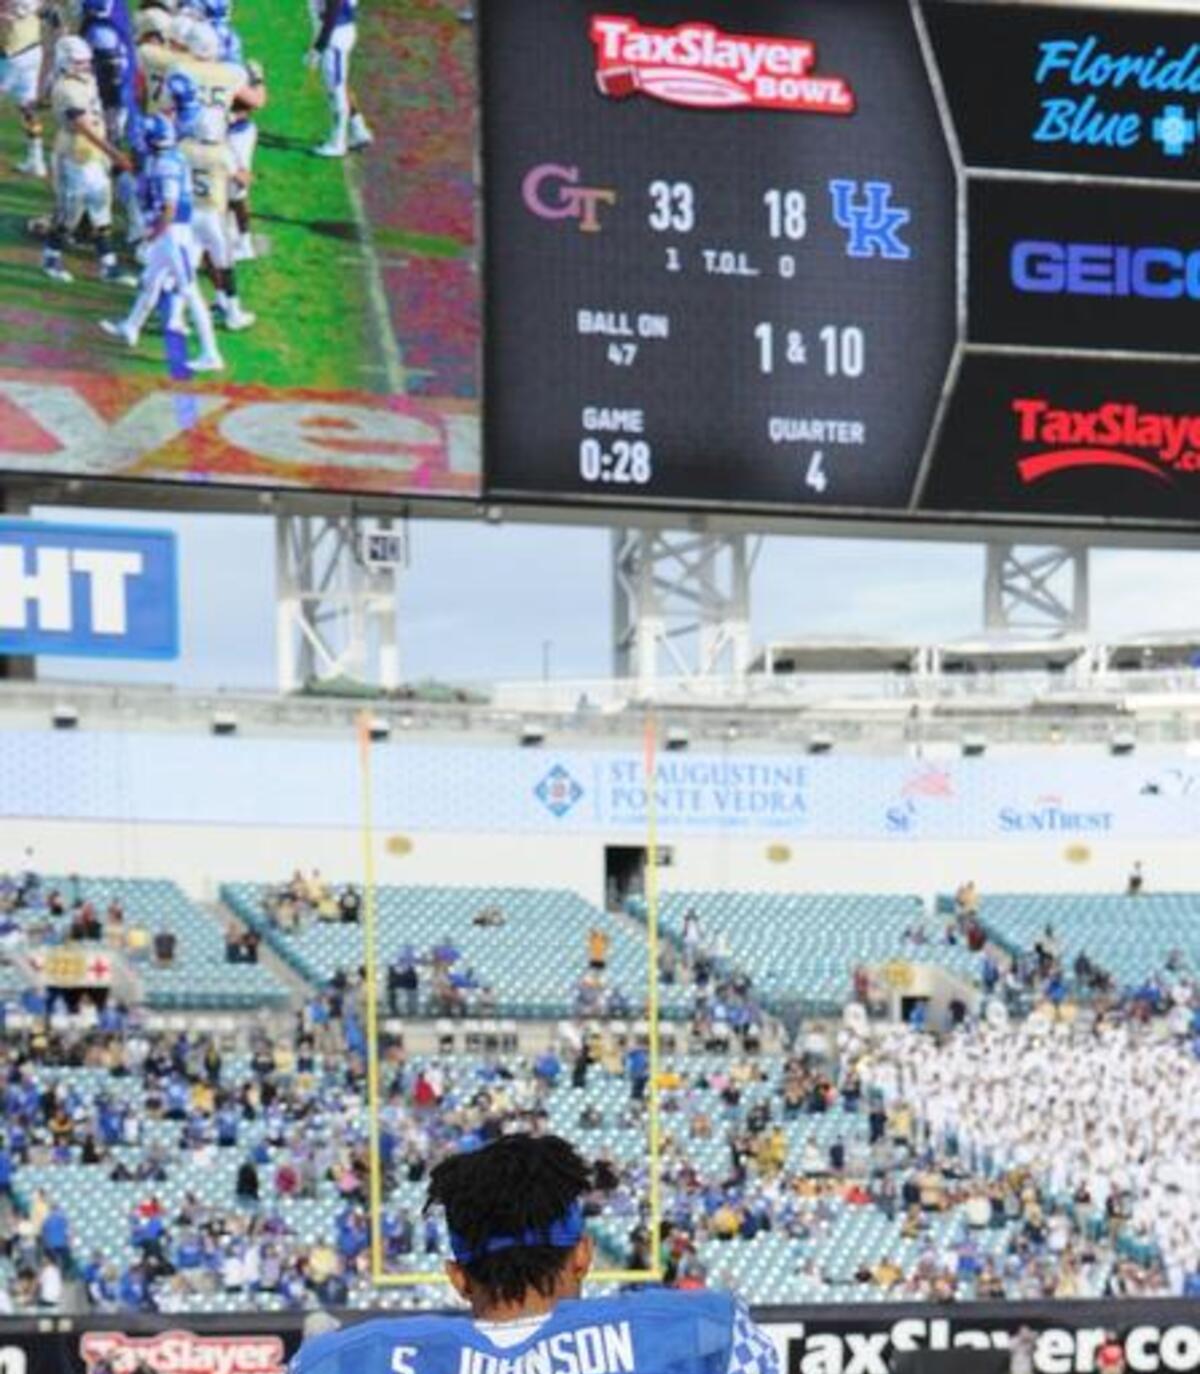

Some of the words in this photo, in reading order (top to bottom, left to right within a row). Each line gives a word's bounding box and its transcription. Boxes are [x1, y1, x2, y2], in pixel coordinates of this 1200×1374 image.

[594, 20, 812, 83] TaxSlayer
[755, 77, 852, 105] BOWL
[1032, 95, 1141, 148] Blue
[648, 181, 694, 232] 33
[764, 189, 806, 239] 18
[829, 179, 911, 259] UK
[666, 247, 681, 272] 1
[778, 254, 796, 279] 0
[1010, 240, 1200, 300] GEIC
[578, 310, 634, 336] BALL
[638, 314, 669, 339] ON
[608, 344, 637, 366] 47
[754, 323, 773, 373] 1
[786, 331, 806, 364] &
[819, 326, 864, 377] 10
[582, 407, 644, 432] GAME
[769, 418, 864, 443] QUARTER
[579, 440, 651, 484] 0:28
[806, 451, 827, 491] 4
[655, 763, 811, 788] AUGUSTINE
[611, 786, 702, 813] PONTE
[712, 789, 809, 815] VEDRA
